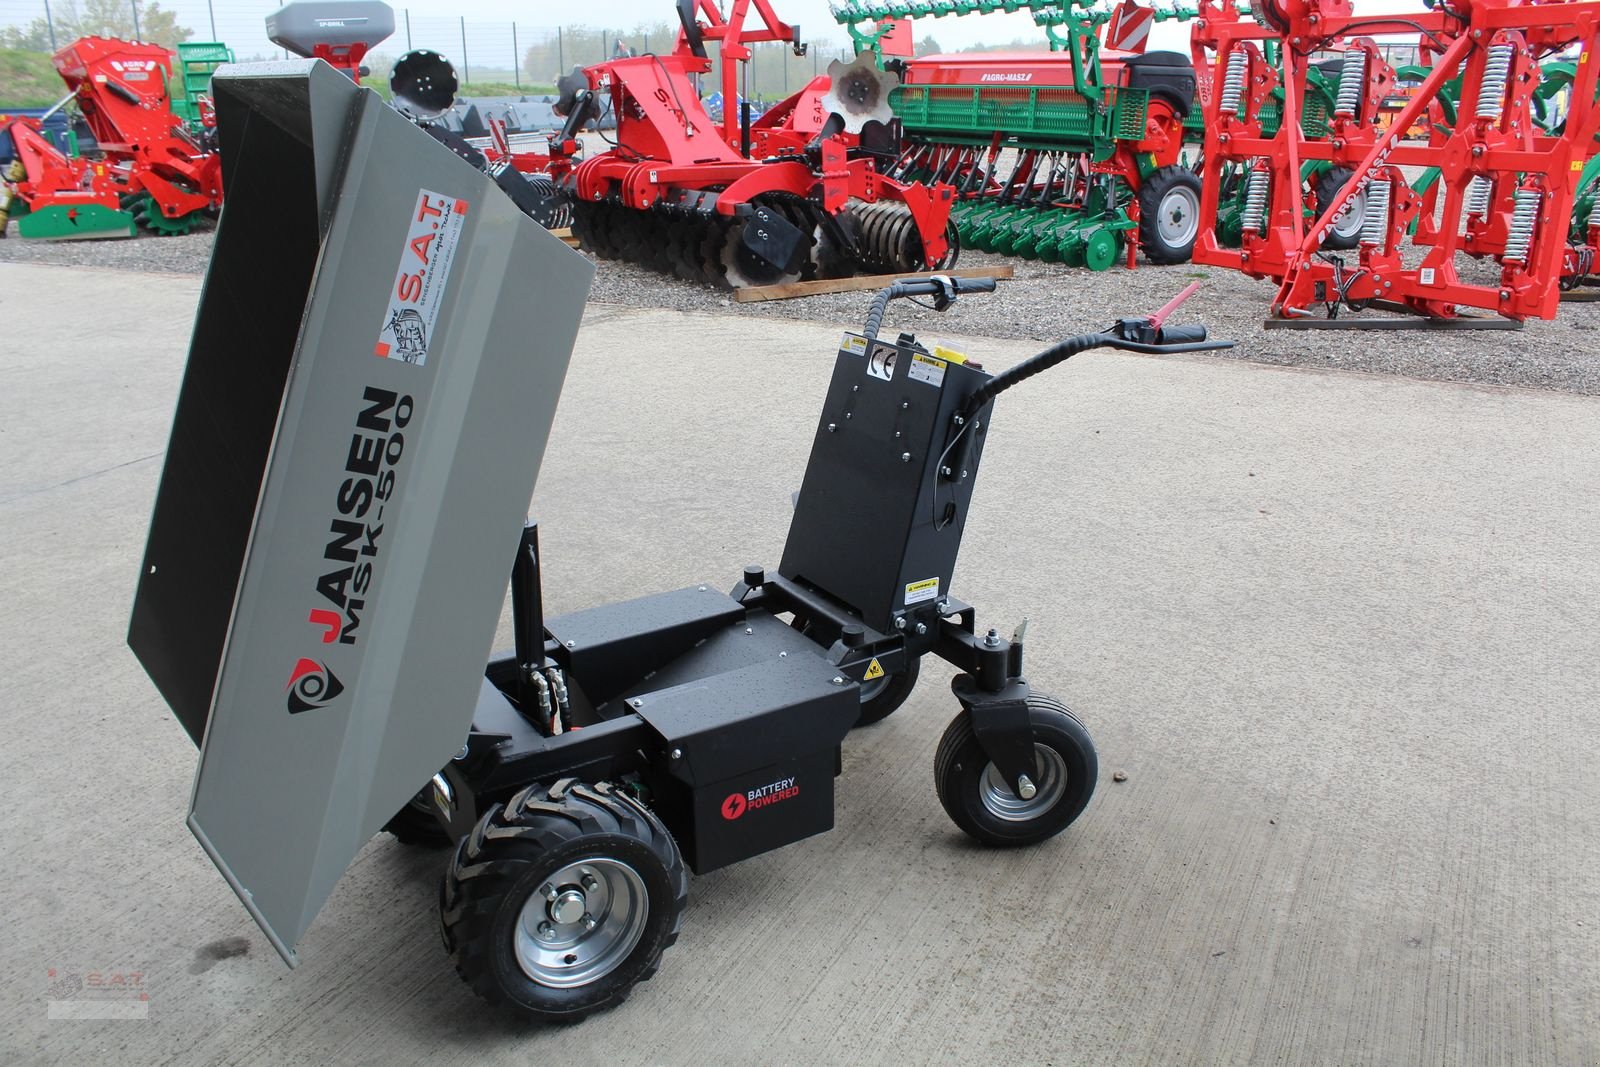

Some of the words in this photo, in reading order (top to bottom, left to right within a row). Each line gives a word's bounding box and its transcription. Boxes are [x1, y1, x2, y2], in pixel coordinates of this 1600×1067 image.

[1325, 148, 1391, 233] AGRO-MASZ
[397, 194, 445, 303] S.A.T.
[308, 386, 398, 644] JANSEN
[339, 394, 414, 645] MSK-500
[747, 777, 794, 800] BATTERY
[748, 786, 799, 810] POWERED
